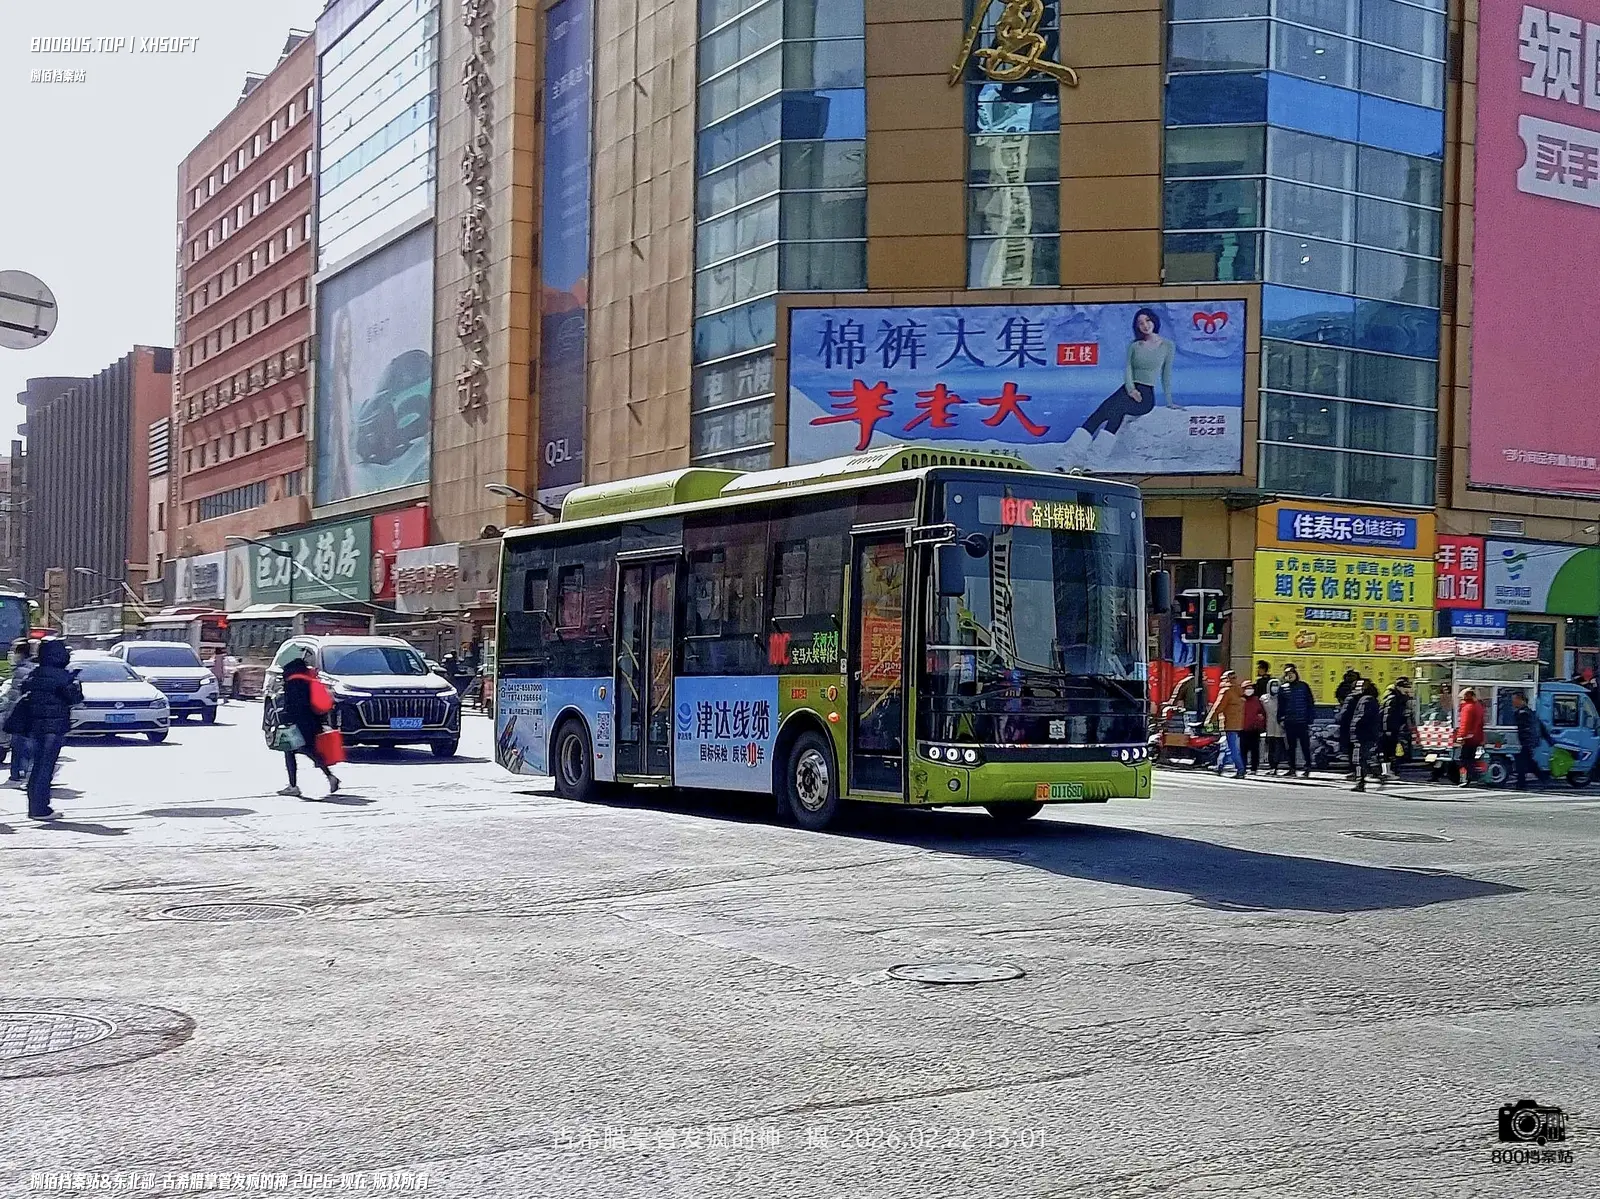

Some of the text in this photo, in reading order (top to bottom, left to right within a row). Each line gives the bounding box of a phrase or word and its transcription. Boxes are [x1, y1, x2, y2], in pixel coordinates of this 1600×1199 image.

[1519, 5, 1600, 112] 领
[818, 317, 1047, 369] 棉裤大集
[1063, 346, 1092, 362] 五楼
[809, 379, 1050, 451] 羊老大
[545, 438, 572, 467] Q5L
[1032, 502, 1096, 531] 奋斗铸就伟业
[256, 527, 361, 588] 巨力大药房
[696, 701, 769, 740] 津达线缆
[700, 744, 728, 762] 国标保检
